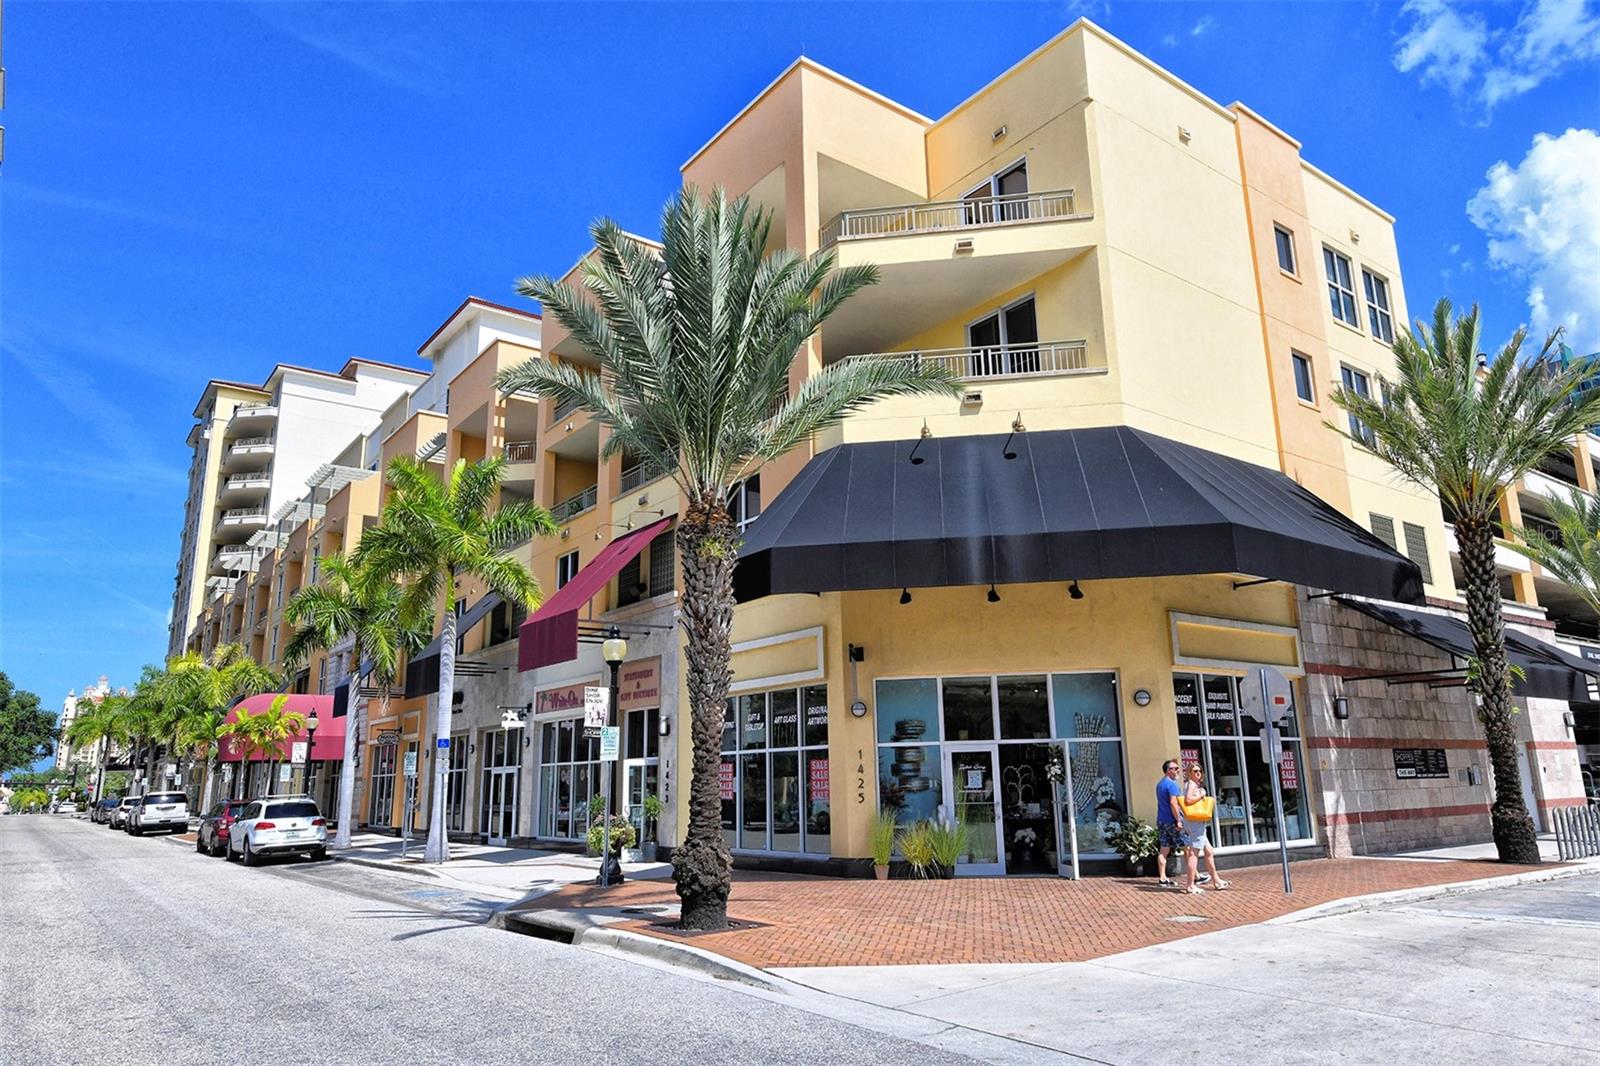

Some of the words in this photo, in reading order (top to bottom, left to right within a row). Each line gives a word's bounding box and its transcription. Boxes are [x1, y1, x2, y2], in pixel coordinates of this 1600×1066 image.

[808, 706, 828, 715] ORIGINA
[774, 716, 783, 724] ART
[783, 714, 797, 723] GLASS
[807, 716, 828, 725] ARTWOR
[1181, 750, 1198, 759] SALE
[1282, 752, 1294, 760] ALE
[811, 760, 828, 769] SALE
[811, 770, 828, 779] SALE
[1282, 771, 1296, 779] SALE
[812, 781, 829, 790] SALE
[1283, 780, 1297, 789] SALE
[812, 791, 829, 800] SALE
